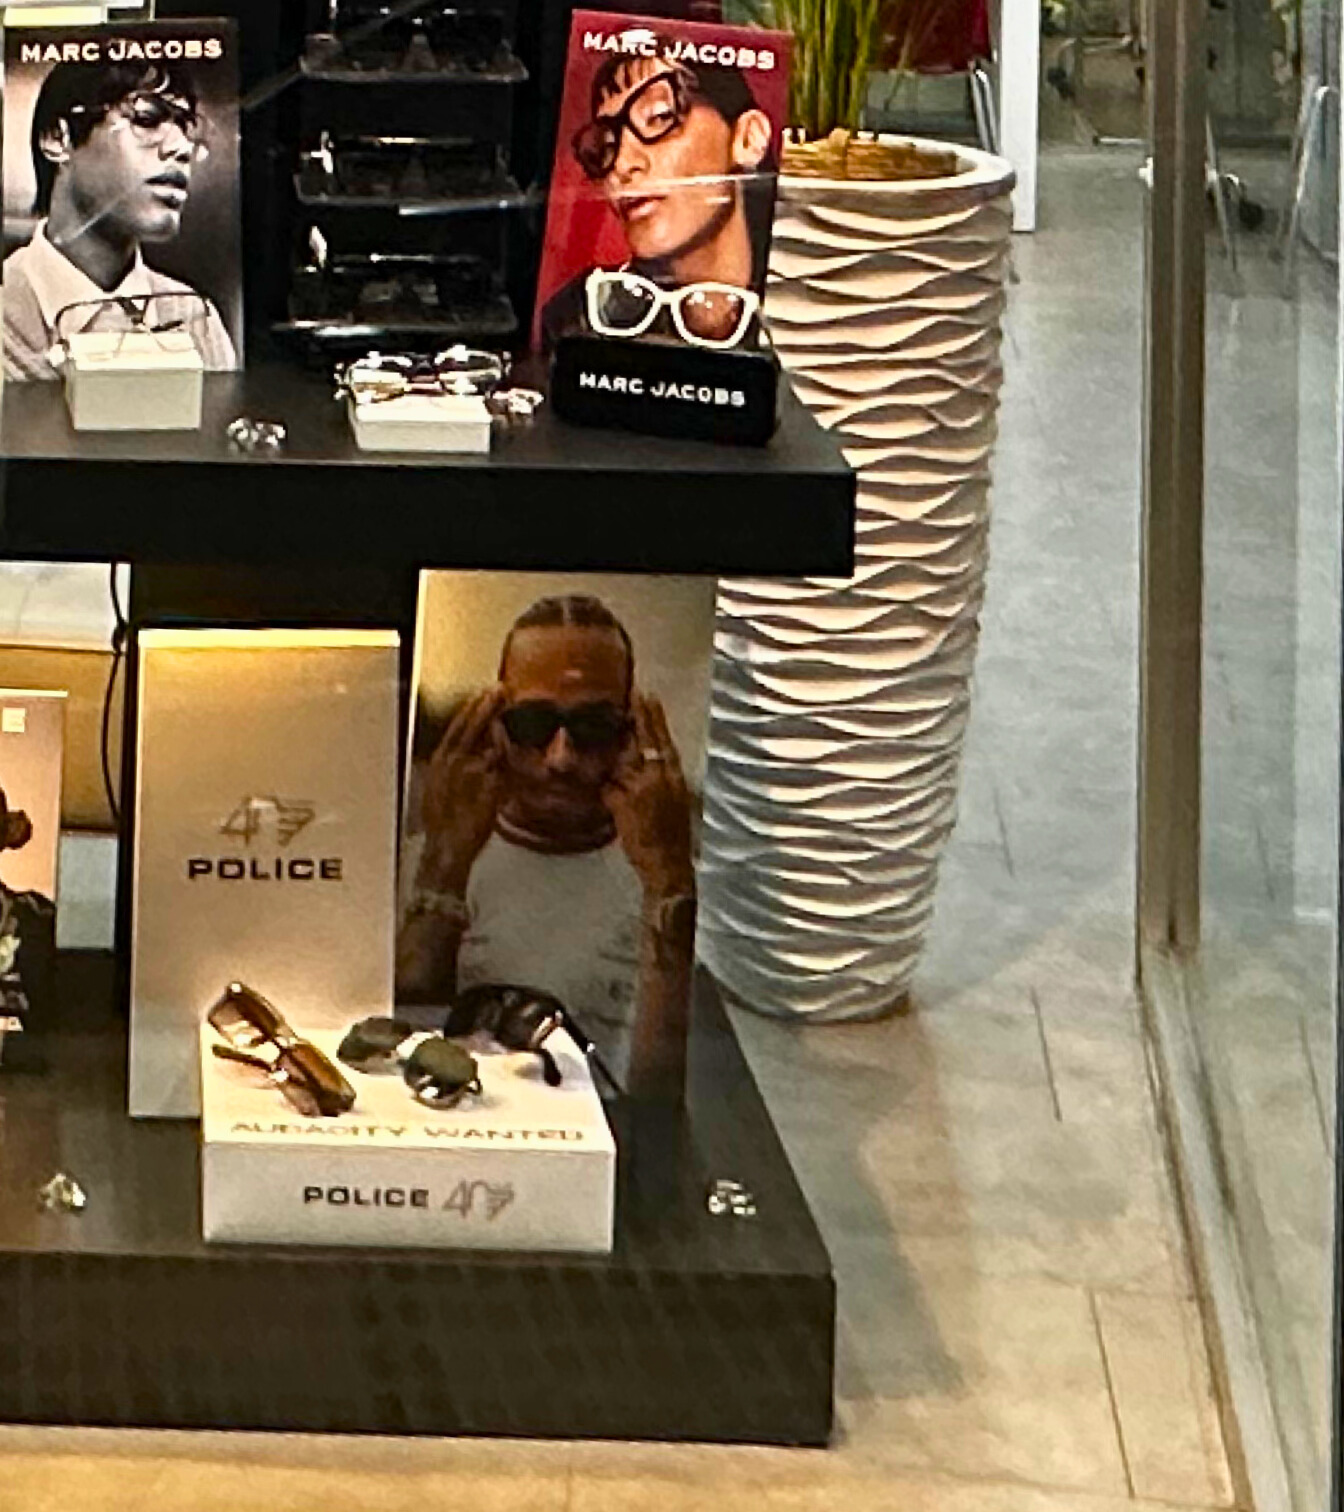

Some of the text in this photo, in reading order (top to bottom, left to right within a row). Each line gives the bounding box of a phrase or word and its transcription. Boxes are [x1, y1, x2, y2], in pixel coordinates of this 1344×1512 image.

[20, 38, 223, 63] MARC JACOBS
[583, 30, 776, 70] MARC JACOBS
[579, 371, 746, 408] MARC JACOBS
[187, 856, 344, 882] POLICE
[231, 1121, 584, 1140] AUDACITY WANTED
[303, 1185, 430, 1207] POLICE
